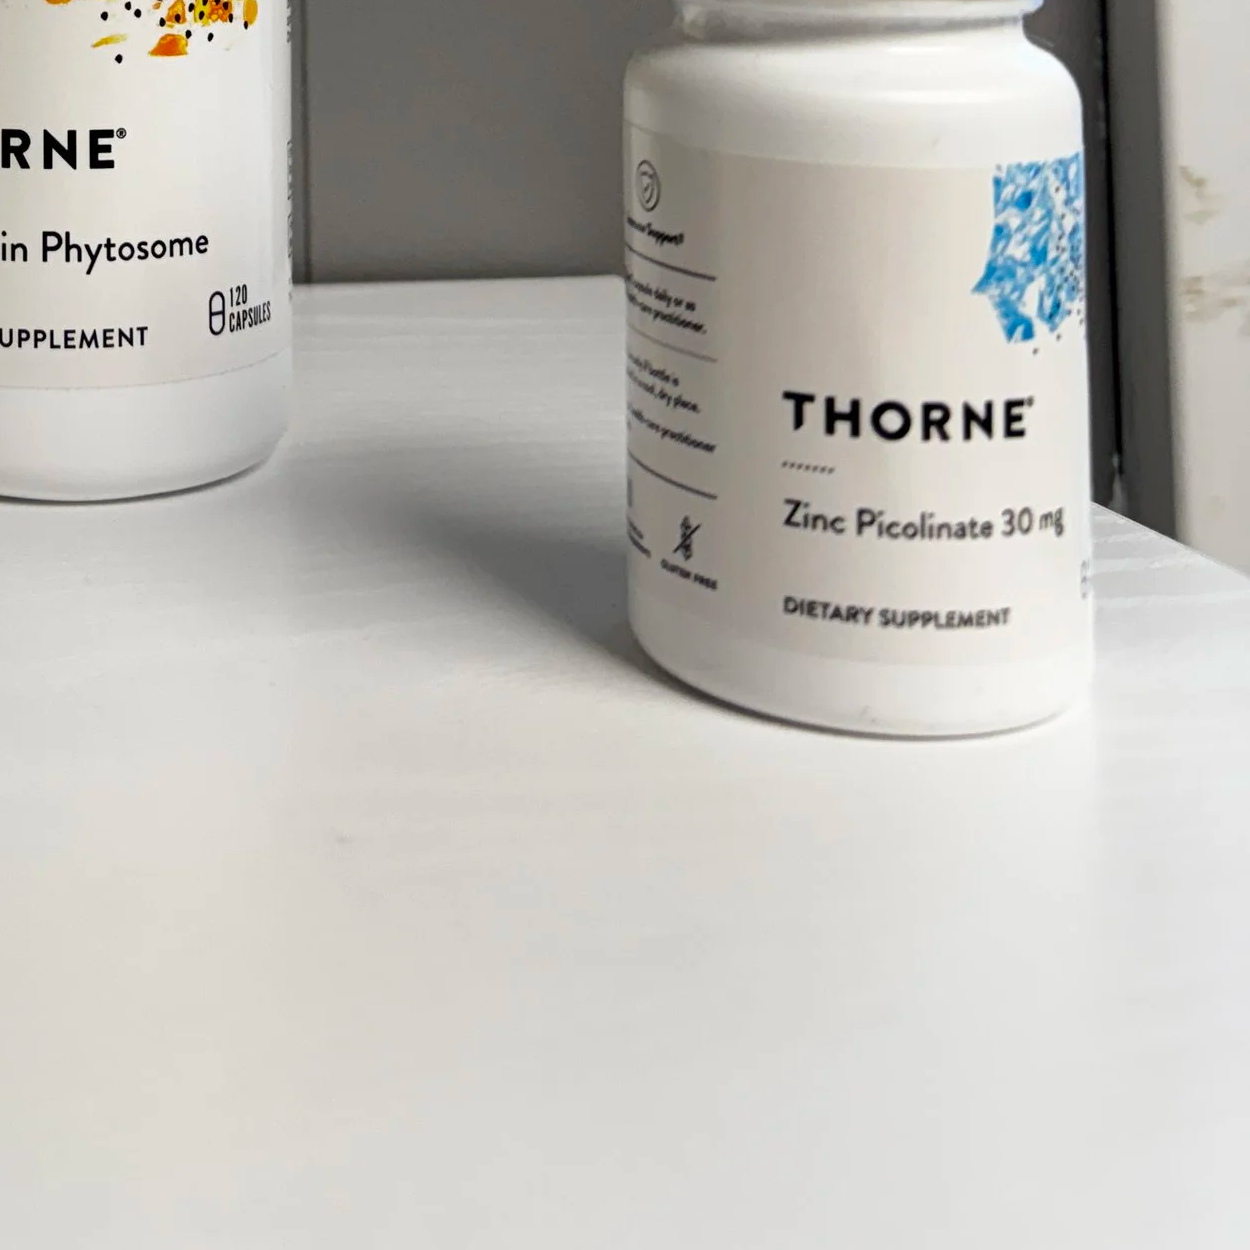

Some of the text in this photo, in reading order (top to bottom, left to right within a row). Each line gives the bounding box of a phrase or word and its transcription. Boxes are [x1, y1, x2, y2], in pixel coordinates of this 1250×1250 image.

[41, 231, 209, 275] Phytosome
[230, 283, 248, 307] 120
[229, 300, 271, 332] CAPSULES
[782, 497, 1064, 541] Zinc Picolinate 30 mg
[783, 596, 1011, 630] DIETARY SUPPLEMENT
